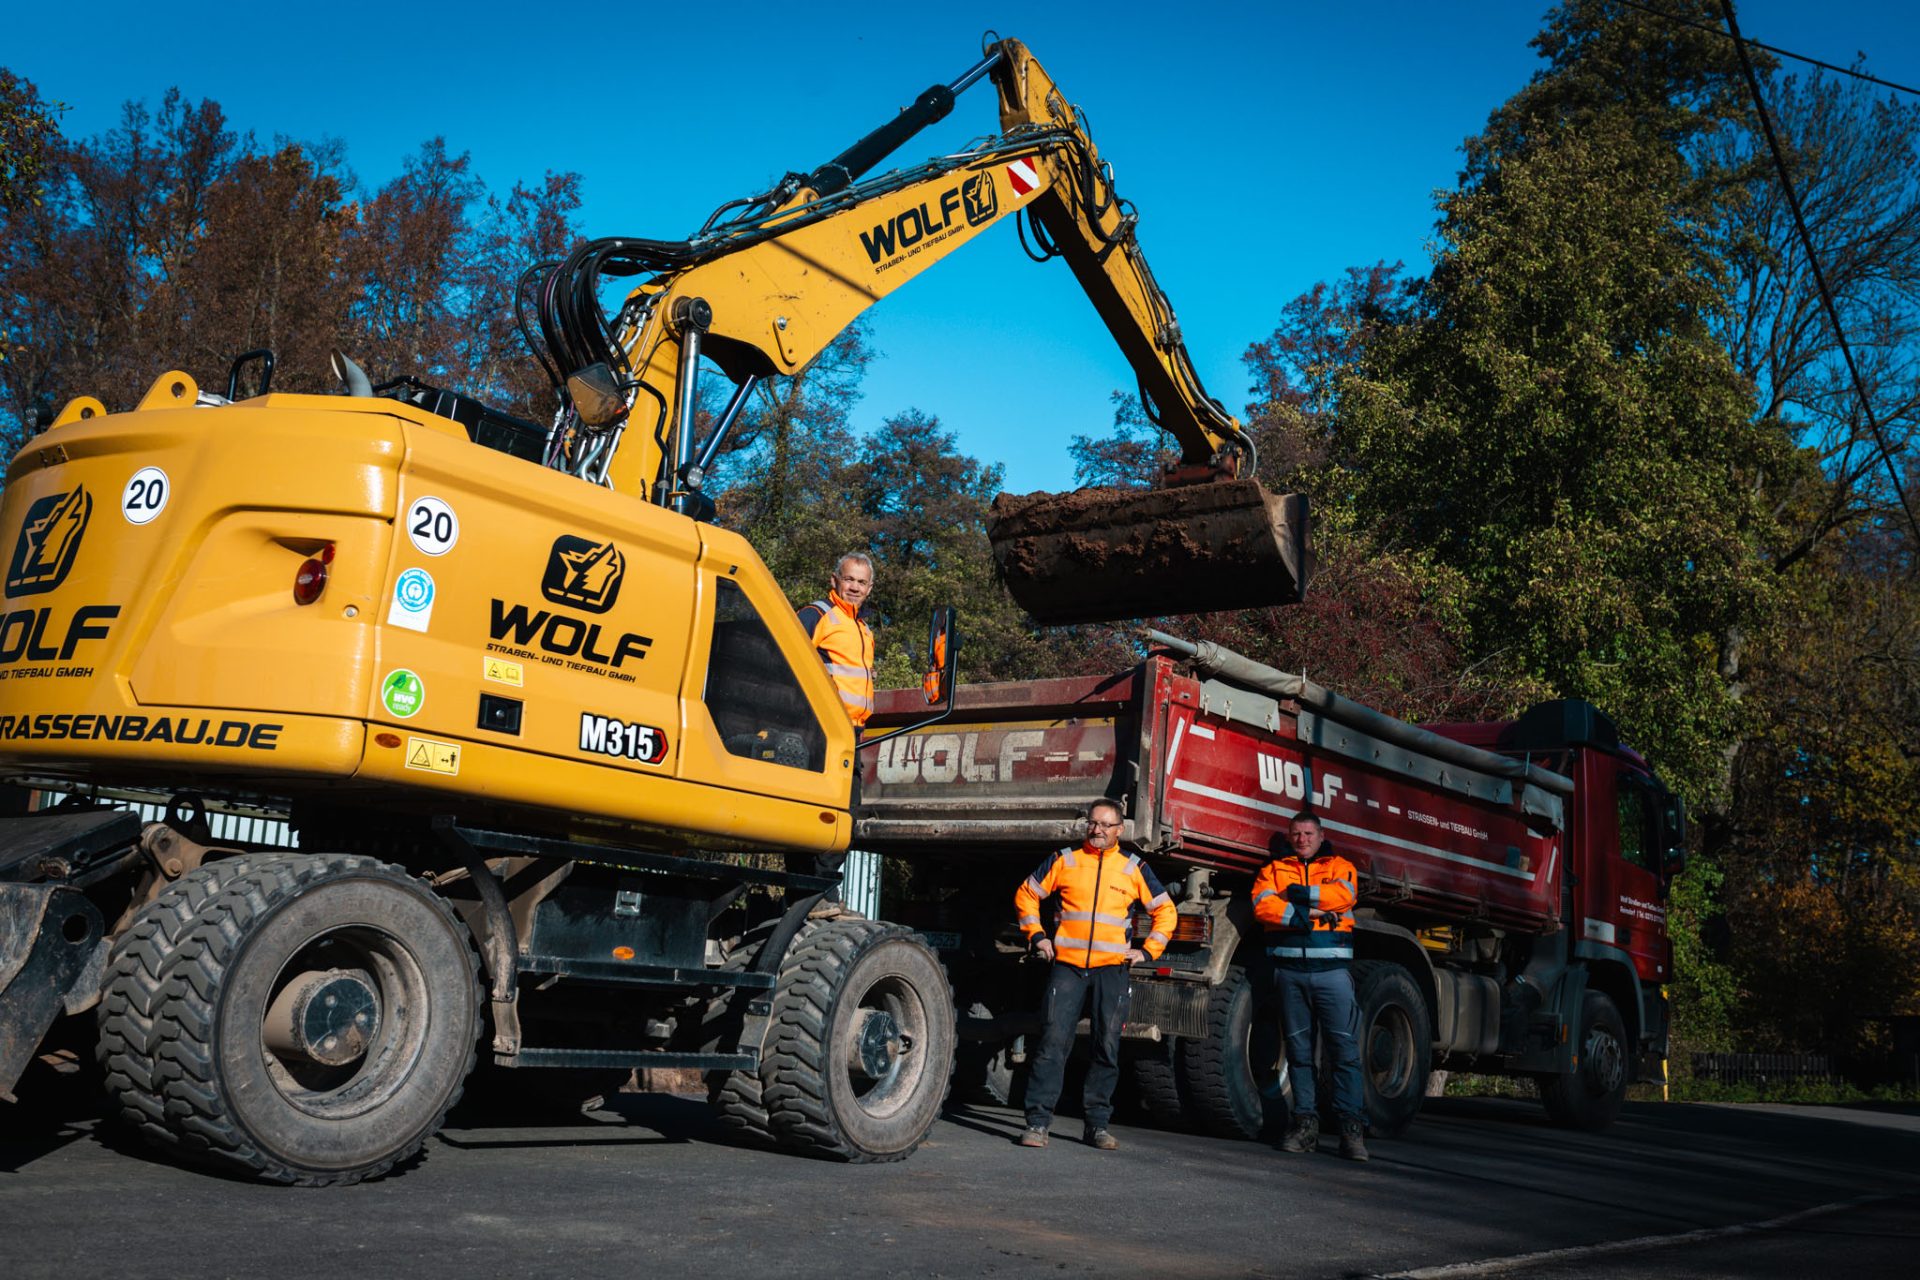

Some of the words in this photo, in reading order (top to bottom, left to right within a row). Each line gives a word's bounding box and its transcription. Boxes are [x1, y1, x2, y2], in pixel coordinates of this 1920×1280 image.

[860, 187, 960, 264] WOLF
[908, 246, 921, 258] UND
[922, 232, 947, 250] TIEFBAU
[126, 478, 164, 510] 20
[412, 505, 453, 544] 20
[0, 605, 121, 664] OLF
[489, 598, 653, 668] WOLF
[11, 668, 54, 679] TIEFBAU
[56, 667, 94, 678] GMBH
[541, 656, 564, 666] UND
[566, 661, 607, 677] TIEFBAU
[608, 671, 636, 683] GMBH
[0, 714, 284, 750] RASSENBAU.DE
[581, 717, 655, 759] M315
[877, 730, 1044, 784] WOLF
[1257, 752, 1343, 809] WOLF
